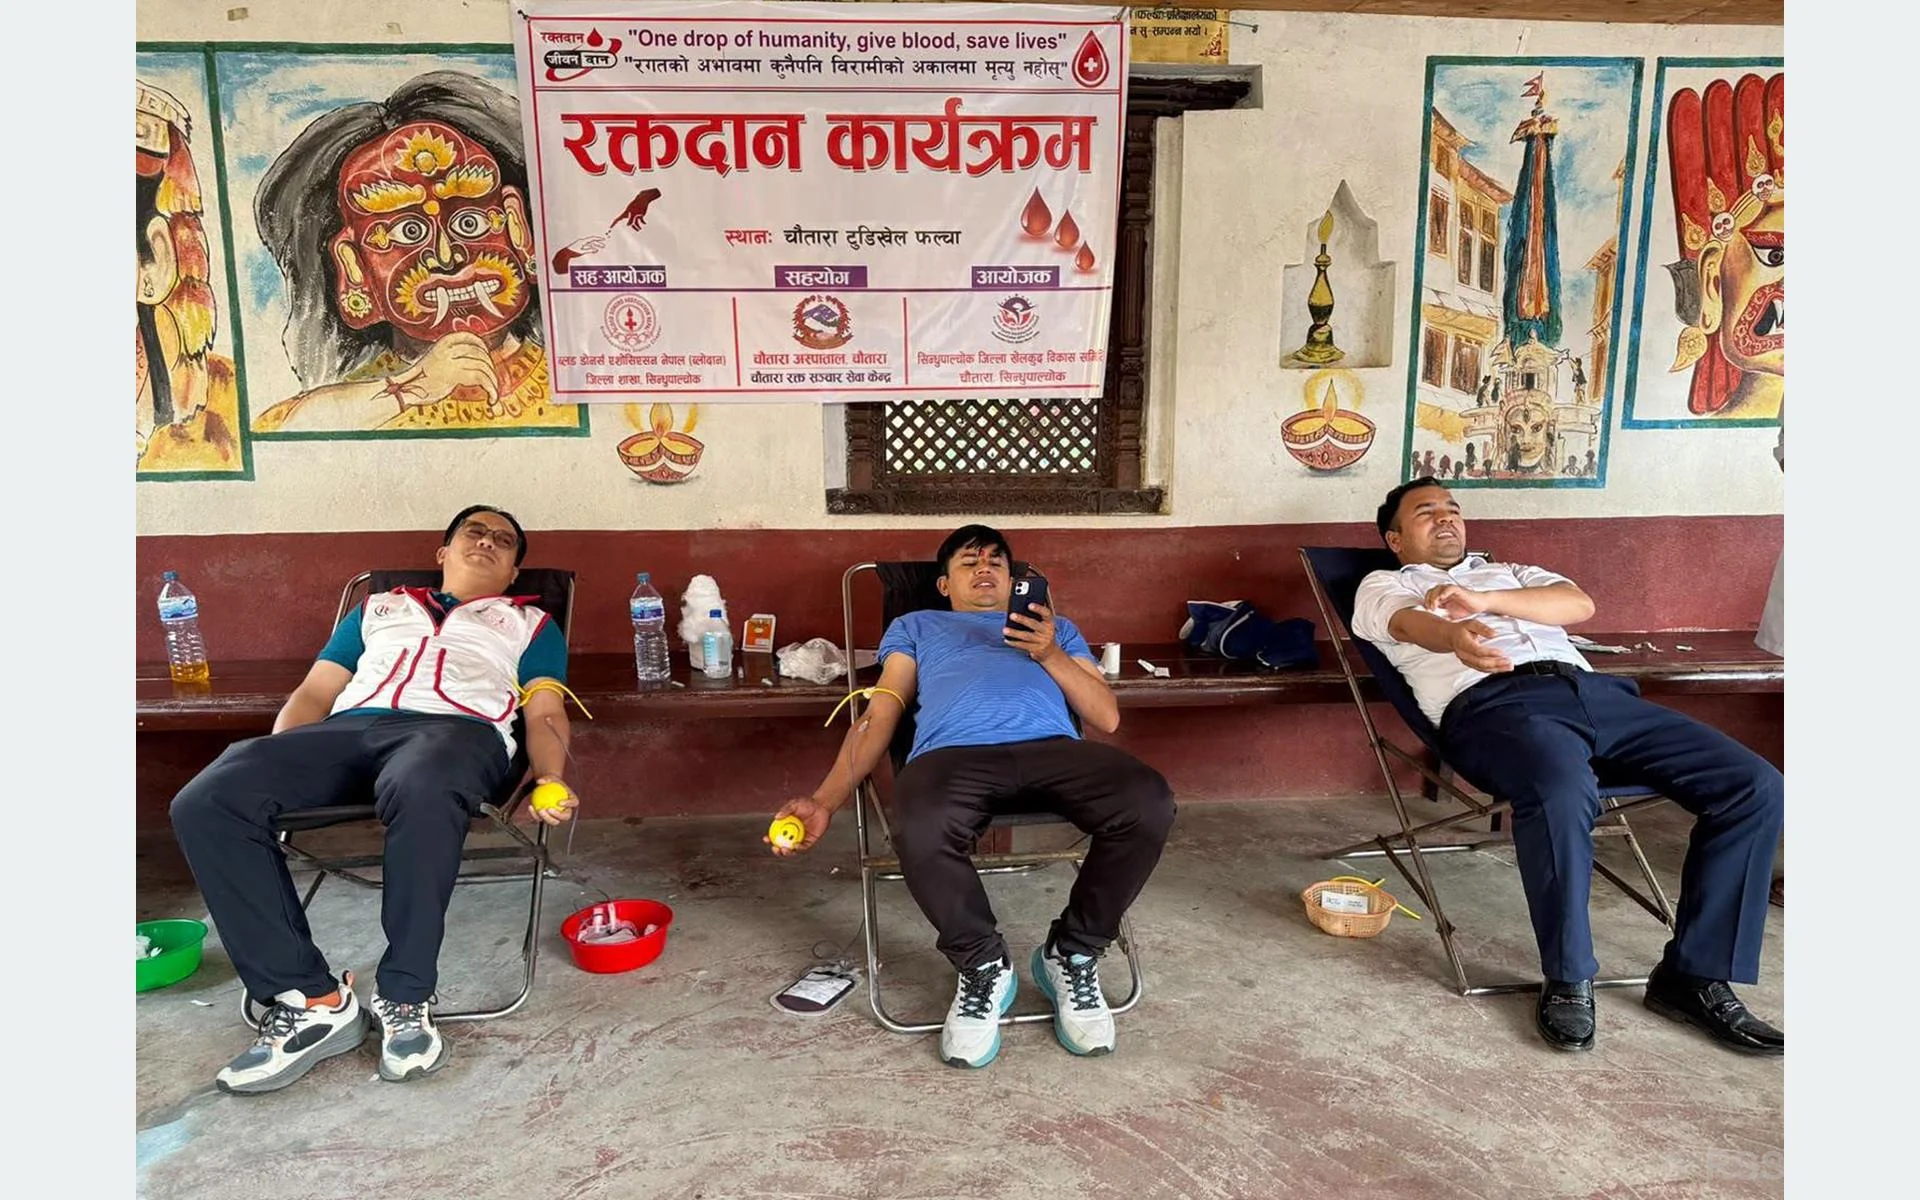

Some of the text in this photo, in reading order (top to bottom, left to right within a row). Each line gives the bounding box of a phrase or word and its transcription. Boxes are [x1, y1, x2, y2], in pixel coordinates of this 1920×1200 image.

[540, 32, 585, 43] रक्तदान
[628, 29, 1067, 53] "One drop of humanity, give blood, save lives"
[546, 52, 609, 65] जीवन दान
[624, 53, 1068, 81] "रगतको अभावमा कुनैपनि विरामीको अकालमा मृत्यु नहोस्"
[560, 97, 1099, 178] रक्तदान कार्यक्रम
[783, 224, 839, 247] चौतारा
[846, 225, 908, 251] टुडिखेल
[915, 230, 962, 247] फल्चा
[574, 267, 665, 286] सह-आयोजक
[784, 267, 850, 286] सहयोग
[976, 266, 1053, 285] आयोजक
[661, 353, 686, 365] नेपाल
[753, 350, 789, 365] चौतारा
[852, 350, 887, 365] चौतारा
[978, 351, 1006, 365] जिल्ला
[1010, 350, 1043, 365] खेलकुद
[1047, 350, 1075, 363] विकास
[586, 373, 614, 385] जिल्ला
[646, 372, 702, 388] सिन्धुपाल्चोक
[751, 371, 783, 384] चौतारा
[787, 373, 806, 384] रक्त
[846, 370, 865, 383] सेवा
[868, 370, 892, 384] केन्द्र
[1000, 369, 1067, 385] सिन्धुपाल्चोक
